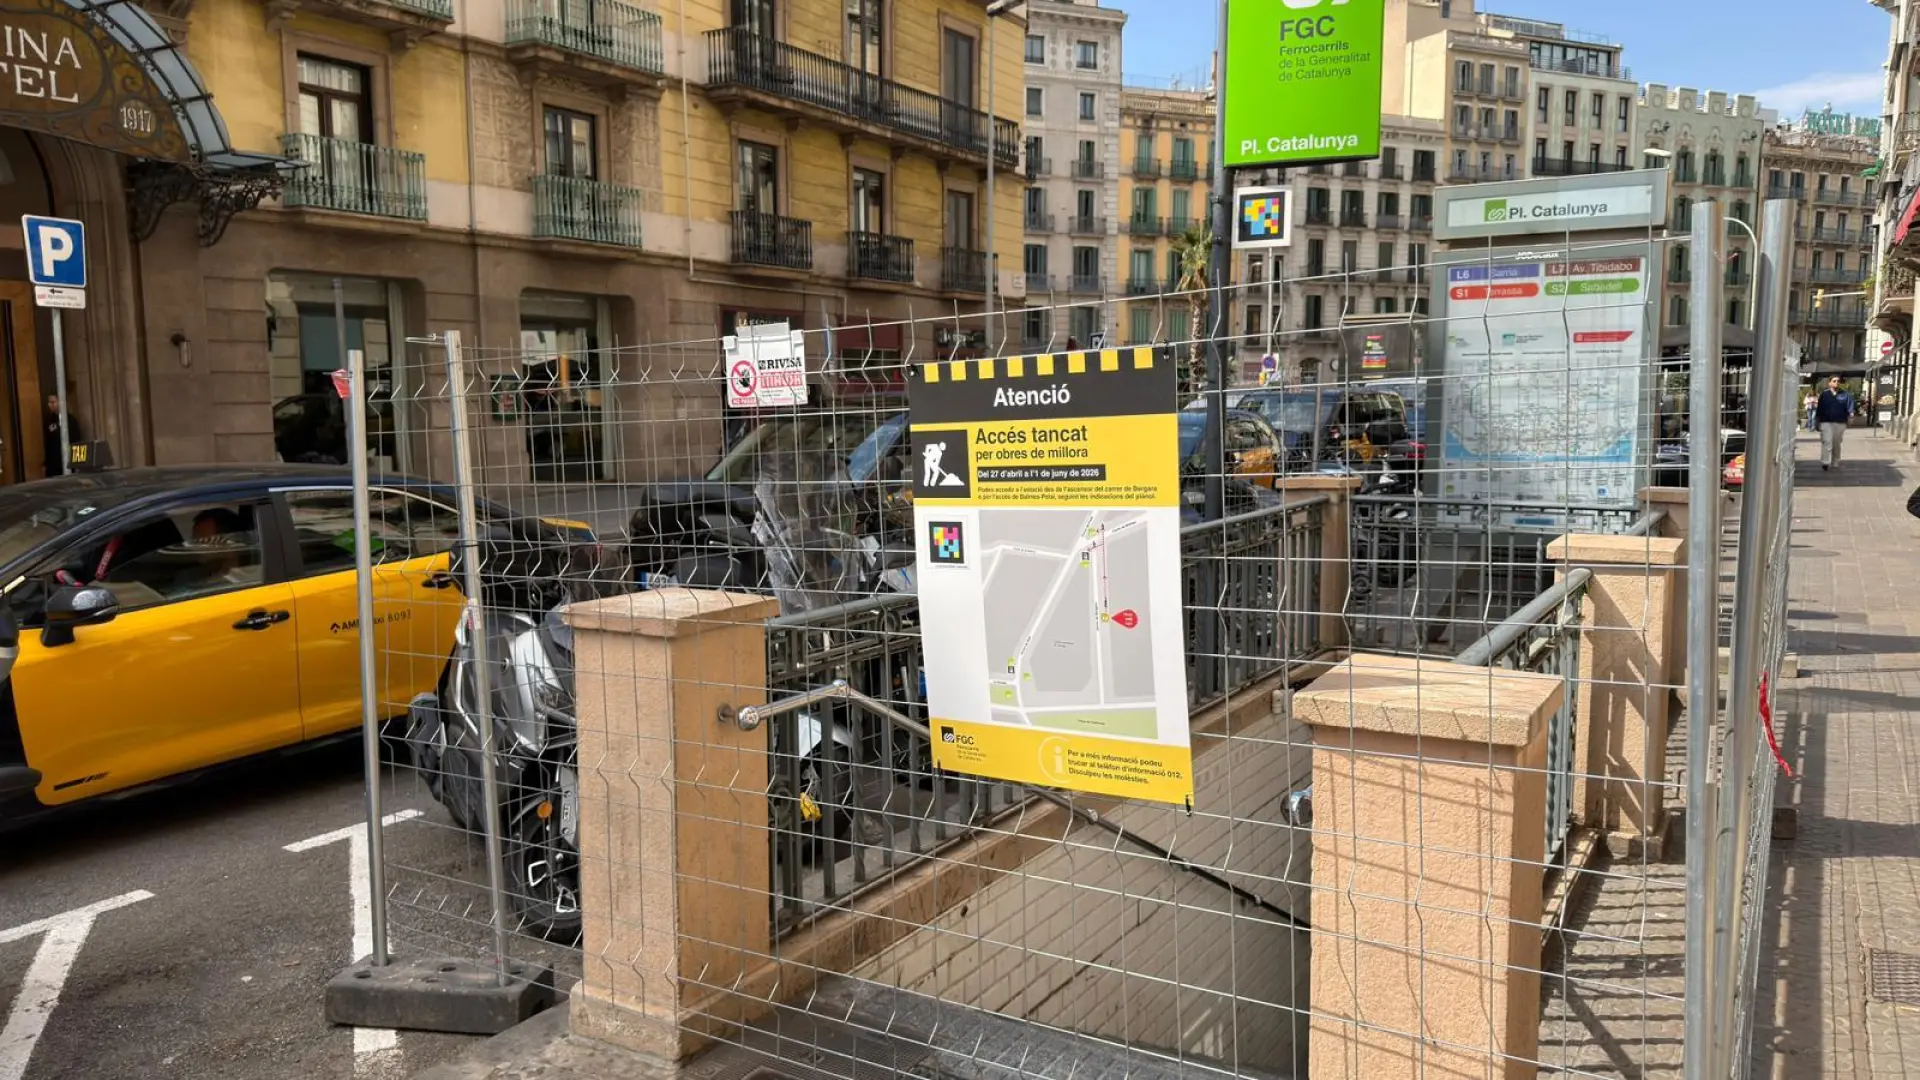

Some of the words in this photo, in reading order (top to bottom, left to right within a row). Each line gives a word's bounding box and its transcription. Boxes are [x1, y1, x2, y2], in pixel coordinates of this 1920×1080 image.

[1280, 15, 1335, 41] FGC
[1279, 40, 1350, 56] Ferrocarrils
[1278, 58, 1293, 69] de
[1296, 56, 1305, 67] la
[1309, 52, 1371, 66] Generalitat
[1278, 71, 1293, 82] de
[1295, 67, 1352, 81] Catalunya
[120, 106, 151, 133] 1917
[1241, 139, 1262, 156] Pl.
[1267, 133, 1358, 152] Catalunya
[1508, 207, 1527, 220] Pl.
[1532, 203, 1608, 219] Catalunya
[38, 225, 73, 277] P
[1456, 269, 1470, 280] L6
[1552, 263, 1566, 274] L7
[1573, 264, 1588, 273] Av.
[1591, 262, 1633, 272] Tibidabo
[1456, 288, 1469, 298] S1
[1551, 284, 1566, 293] S2
[1580, 281, 1623, 292] Sabadell
[993, 383, 1071, 407] Atenció
[976, 427, 1027, 445] Accés
[1032, 425, 1088, 443] tancat
[72, 444, 87, 463] TAXI
[975, 450, 994, 463] per
[996, 447, 1029, 460] obres
[1031, 447, 1045, 459] de
[1048, 446, 1088, 459] millora
[977, 469, 989, 478] Del
[990, 469, 999, 478] 27
[1000, 469, 1023, 478] d'abril
[1040, 469, 1050, 478] de
[1051, 469, 1068, 479] juny
[1069, 468, 1079, 477] de
[1080, 468, 1099, 477] 2026
[956, 734, 974, 745] FGC
[1067, 749, 1079, 757] Per
[1086, 752, 1100, 760] més
[1102, 754, 1139, 764] informació
[1140, 758, 1163, 768] podeu
[1067, 759, 1088, 767] trucar
[1097, 762, 1122, 771] telèfon
[1122, 765, 1166, 777] d'informació
[1167, 771, 1183, 780] 012.
[1068, 767, 1101, 778] Disculpeu
[1114, 773, 1149, 784] molèsties.
